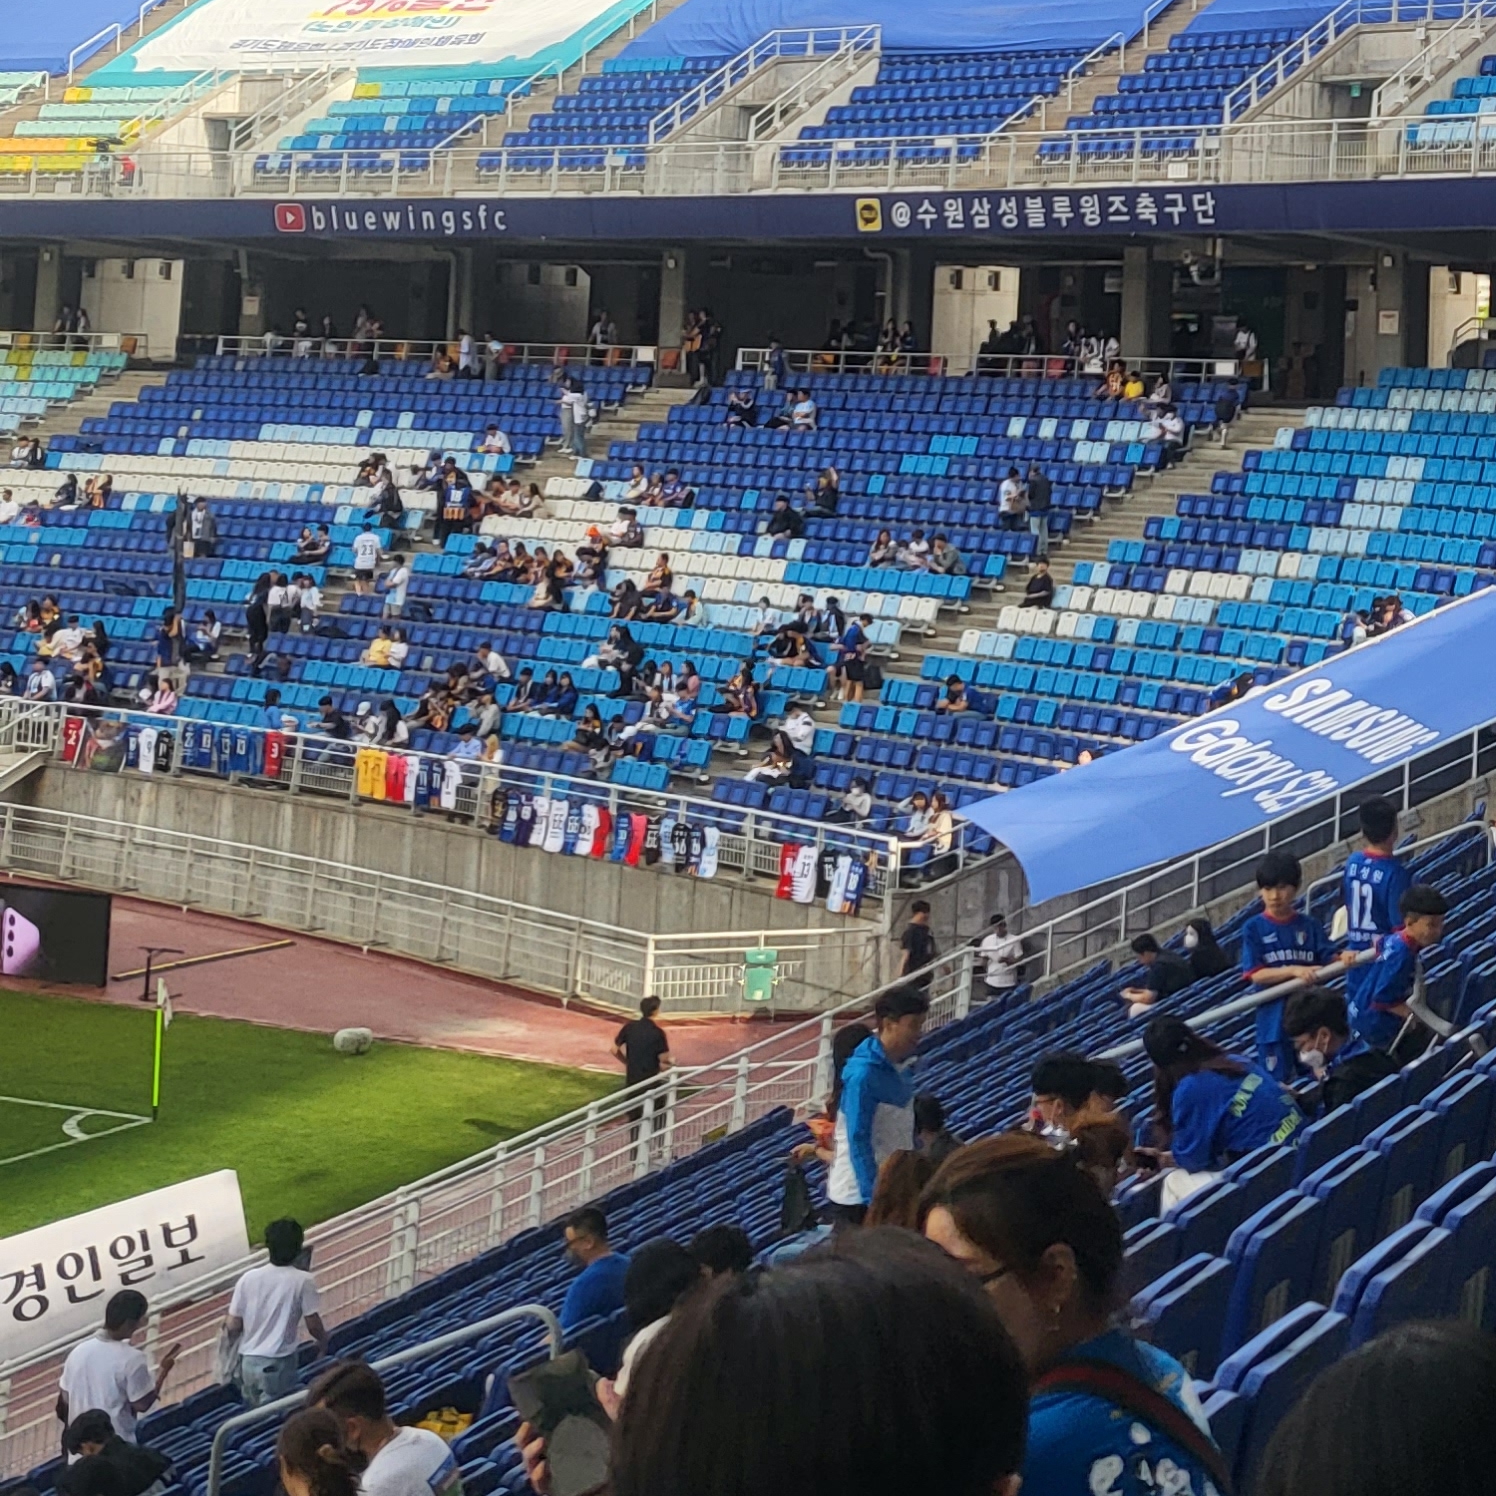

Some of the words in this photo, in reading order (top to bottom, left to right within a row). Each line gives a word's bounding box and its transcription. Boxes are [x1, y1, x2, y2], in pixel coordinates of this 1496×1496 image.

[311, 205, 508, 236] bluewingsfc
[1169, 719, 1303, 798] Galaxy
[1263, 678, 1440, 765] SAMSUNG
[1351, 879, 1378, 931] 12
[0, 1213, 206, 1322] 경인일보
